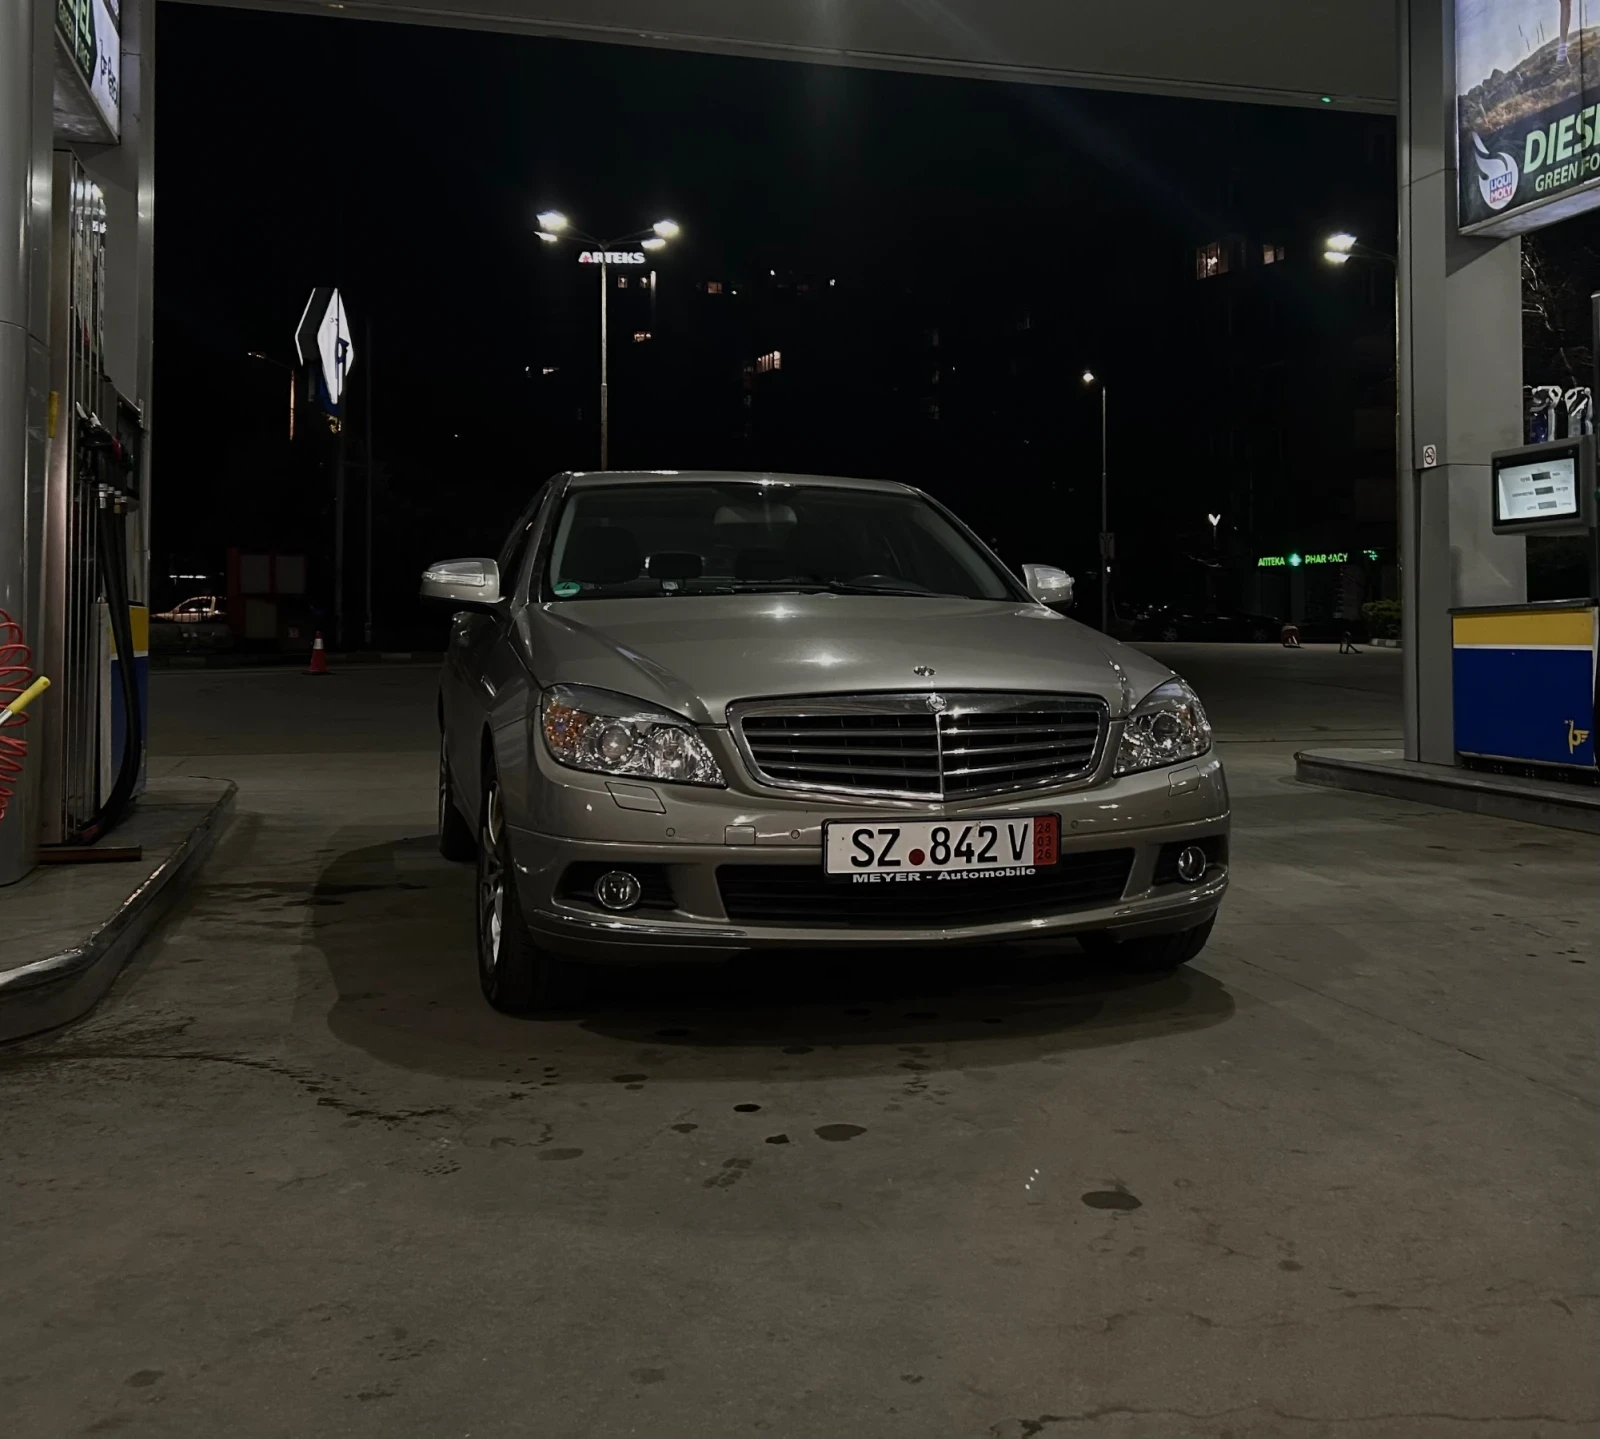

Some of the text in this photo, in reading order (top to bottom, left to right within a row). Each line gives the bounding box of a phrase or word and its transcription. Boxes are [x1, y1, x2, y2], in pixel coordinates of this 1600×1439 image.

[1535, 152, 1600, 192] GREEN FO
[1491, 173, 1512, 191] LIQUI
[1491, 185, 1512, 203] MOLY
[578, 252, 646, 264] ARTEKS
[1036, 822, 1051, 834] 28
[850, 823, 1029, 867] SZ 842 V
[1037, 835, 1051, 847] 03
[1036, 848, 1051, 860] 26
[852, 872, 921, 883] MEYER
[937, 867, 1036, 881] Automobile
